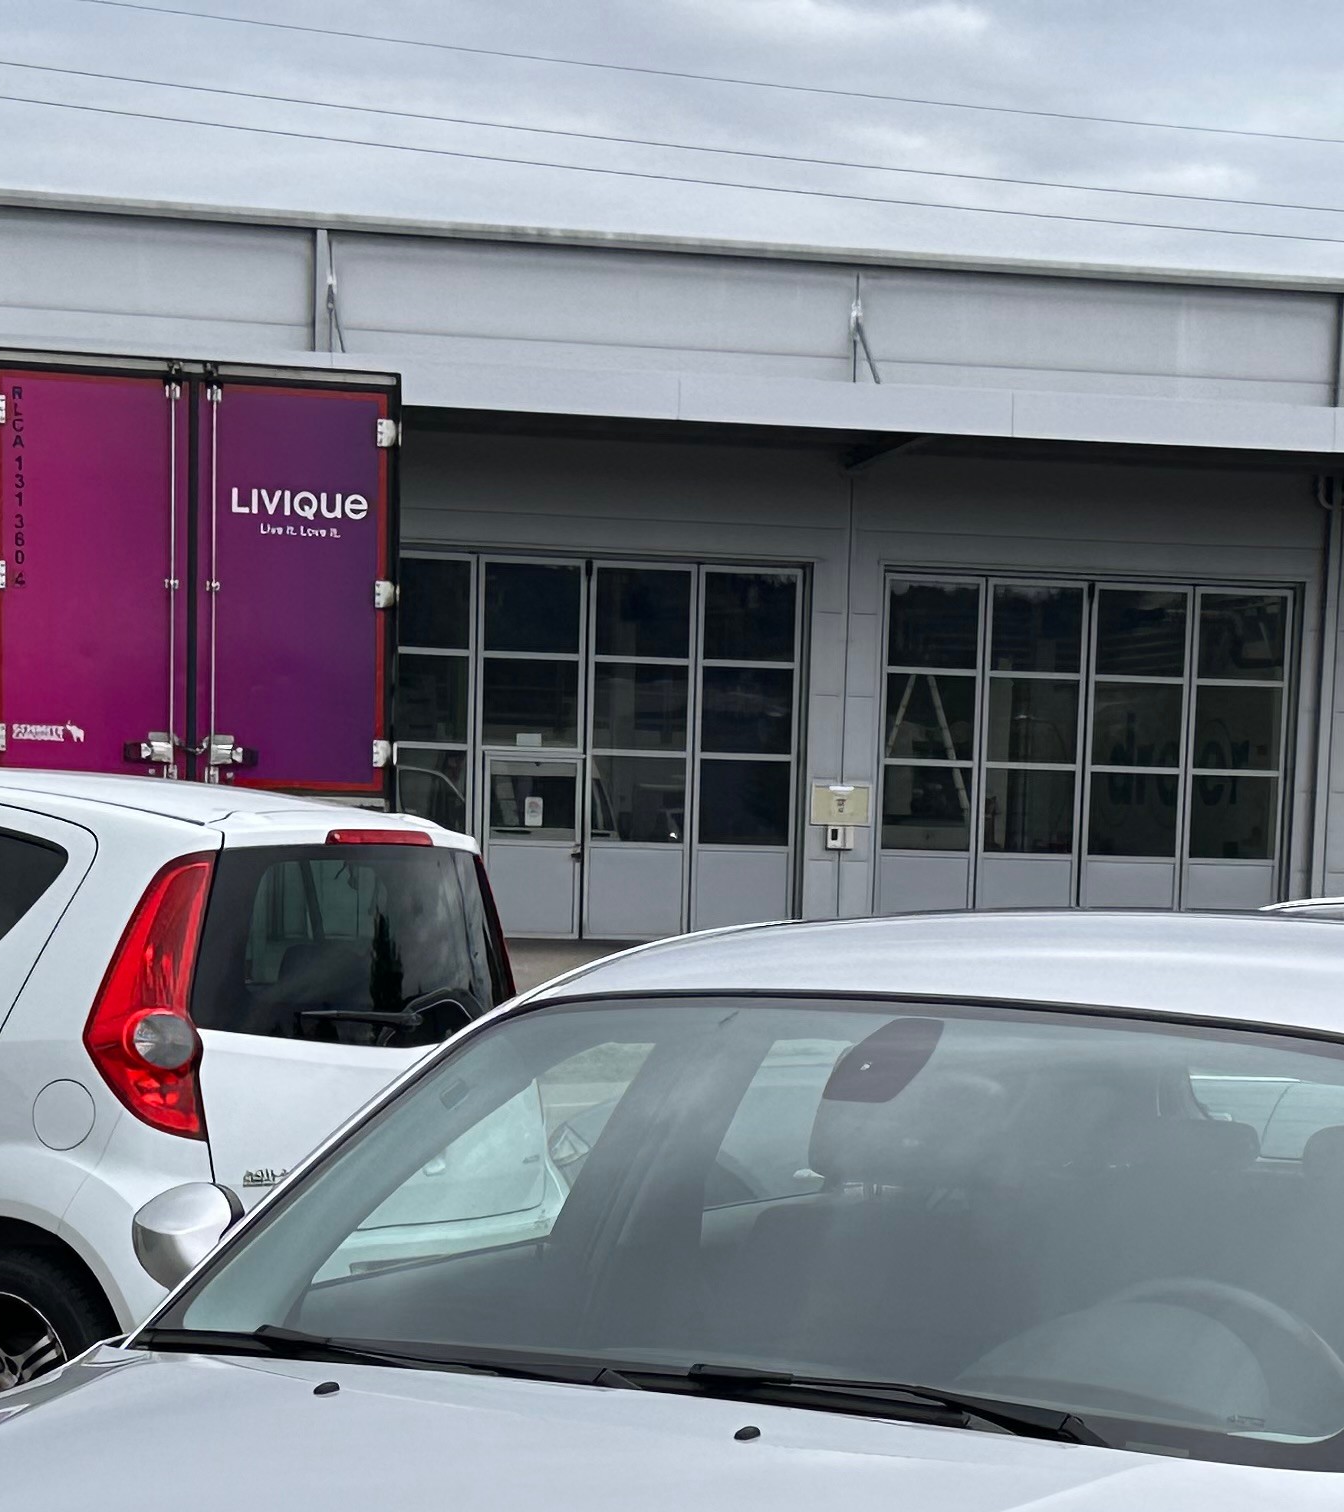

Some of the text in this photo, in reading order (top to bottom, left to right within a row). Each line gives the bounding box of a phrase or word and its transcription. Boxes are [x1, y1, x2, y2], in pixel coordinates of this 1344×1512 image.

[12, 386, 25, 449] RLCA
[14, 455, 25, 507] 131
[14, 513, 25, 565] 360
